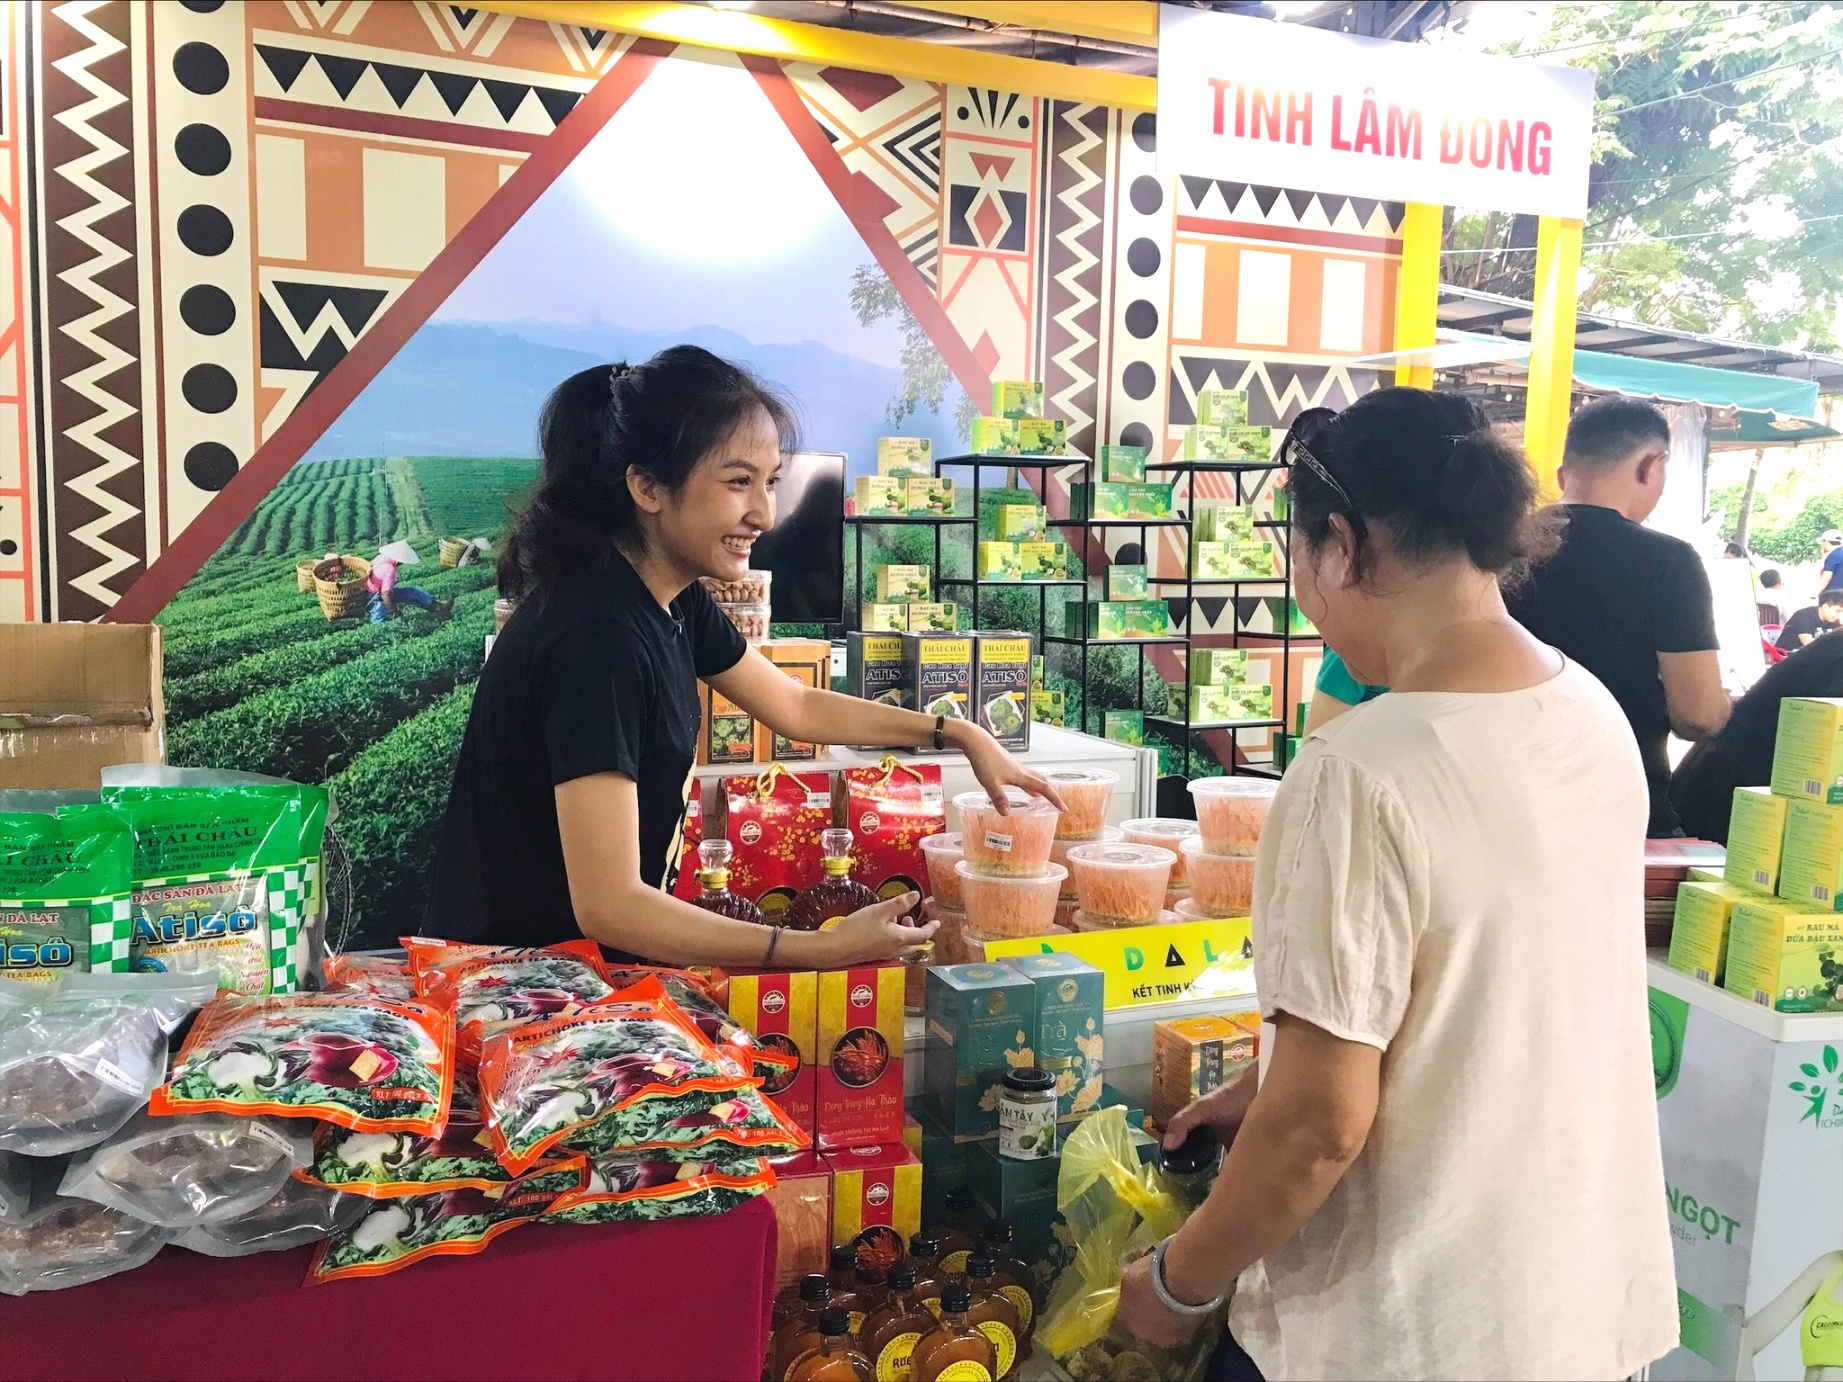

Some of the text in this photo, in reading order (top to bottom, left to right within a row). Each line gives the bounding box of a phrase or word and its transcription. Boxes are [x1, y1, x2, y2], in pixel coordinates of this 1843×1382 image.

[1330, 86, 1422, 160] LÂM
[922, 667, 969, 684] ATISÔ
[981, 666, 1027, 683] ATISÔ
[195, 825, 258, 842] CHÂU
[164, 886, 192, 900] SẢN
[195, 883, 215, 896] ĐÀ
[7, 911, 60, 926] ĐÀ LẠT
[1806, 920, 1840, 932] RAU MÁ
[199, 941, 215, 950] TEA
[217, 937, 241, 948] BAGS
[26, 970, 53, 978] BAGS
[1132, 983, 1153, 999] KẾT
[1155, 982, 1182, 996] TINH
[513, 1020, 588, 1044] ARTICHOKE
[592, 1017, 615, 1025] TEA
[1014, 1109, 1034, 1122] TÂY
